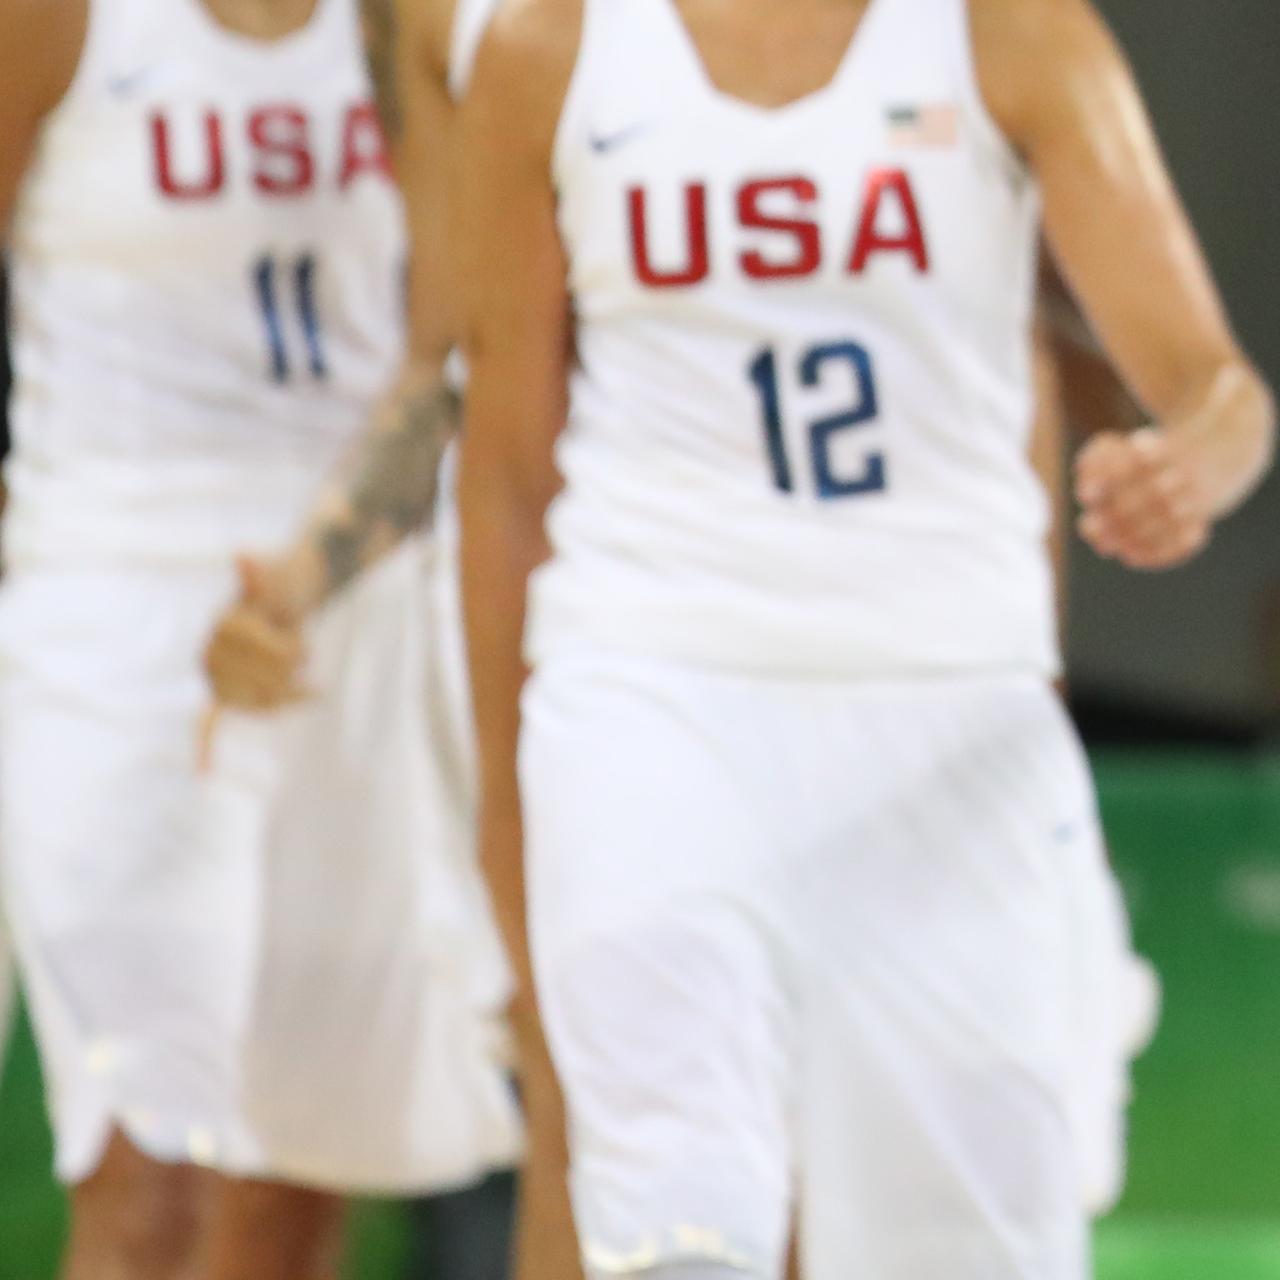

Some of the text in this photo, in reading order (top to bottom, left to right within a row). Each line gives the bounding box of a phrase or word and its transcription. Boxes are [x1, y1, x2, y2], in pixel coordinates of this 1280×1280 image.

[149, 99, 397, 202] USA
[625, 166, 933, 289] USA
[251, 248, 329, 384] 11
[746, 338, 887, 498] 12
